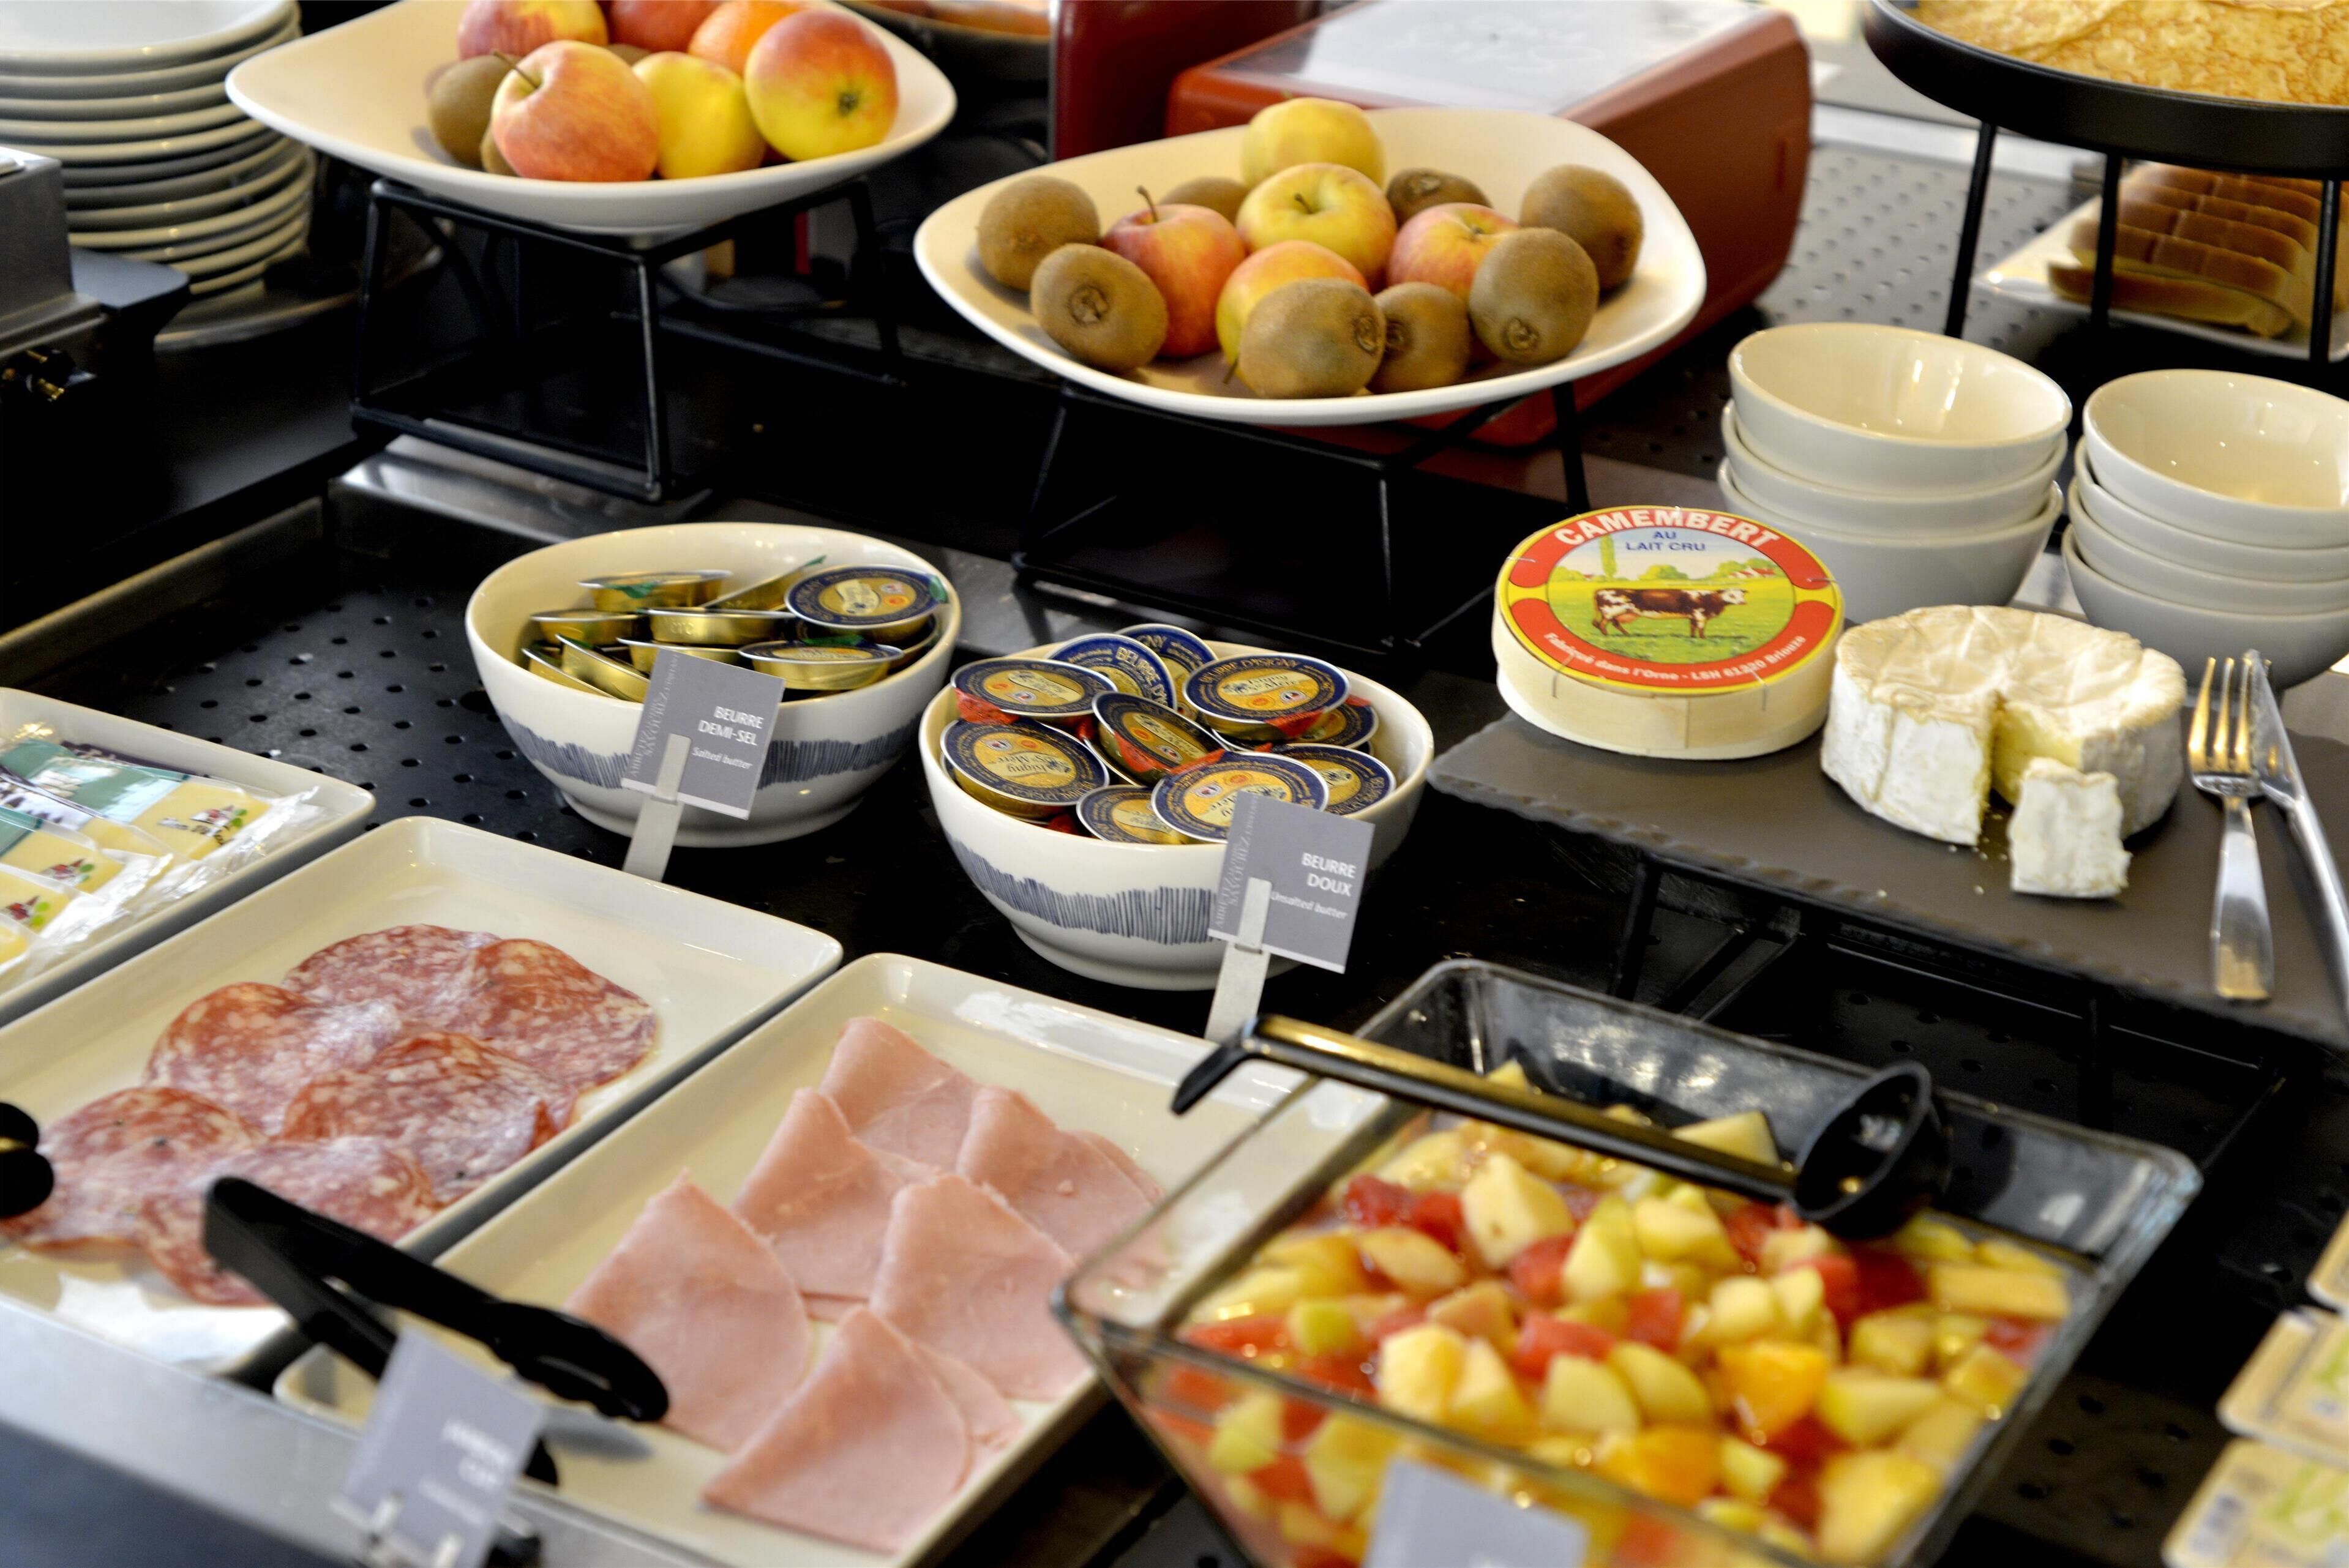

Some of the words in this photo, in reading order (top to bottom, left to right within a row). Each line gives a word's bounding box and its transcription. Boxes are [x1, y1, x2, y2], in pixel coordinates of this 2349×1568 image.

[1554, 509, 1780, 547] CAMEMBERT
[1626, 542, 1665, 551] LAIT
[1669, 542, 1706, 551] CRU
[1595, 660, 1630, 674] dans
[714, 706, 764, 729] BEURRE
[697, 719, 757, 746] DEMI-SEL
[691, 747, 723, 762] Salted
[722, 755, 754, 769] butter
[1302, 852, 1356, 878] BEURRE
[1307, 873, 1352, 897] DOUX
[1270, 890, 1315, 911] Unsalted
[1314, 903, 1348, 919] butter
